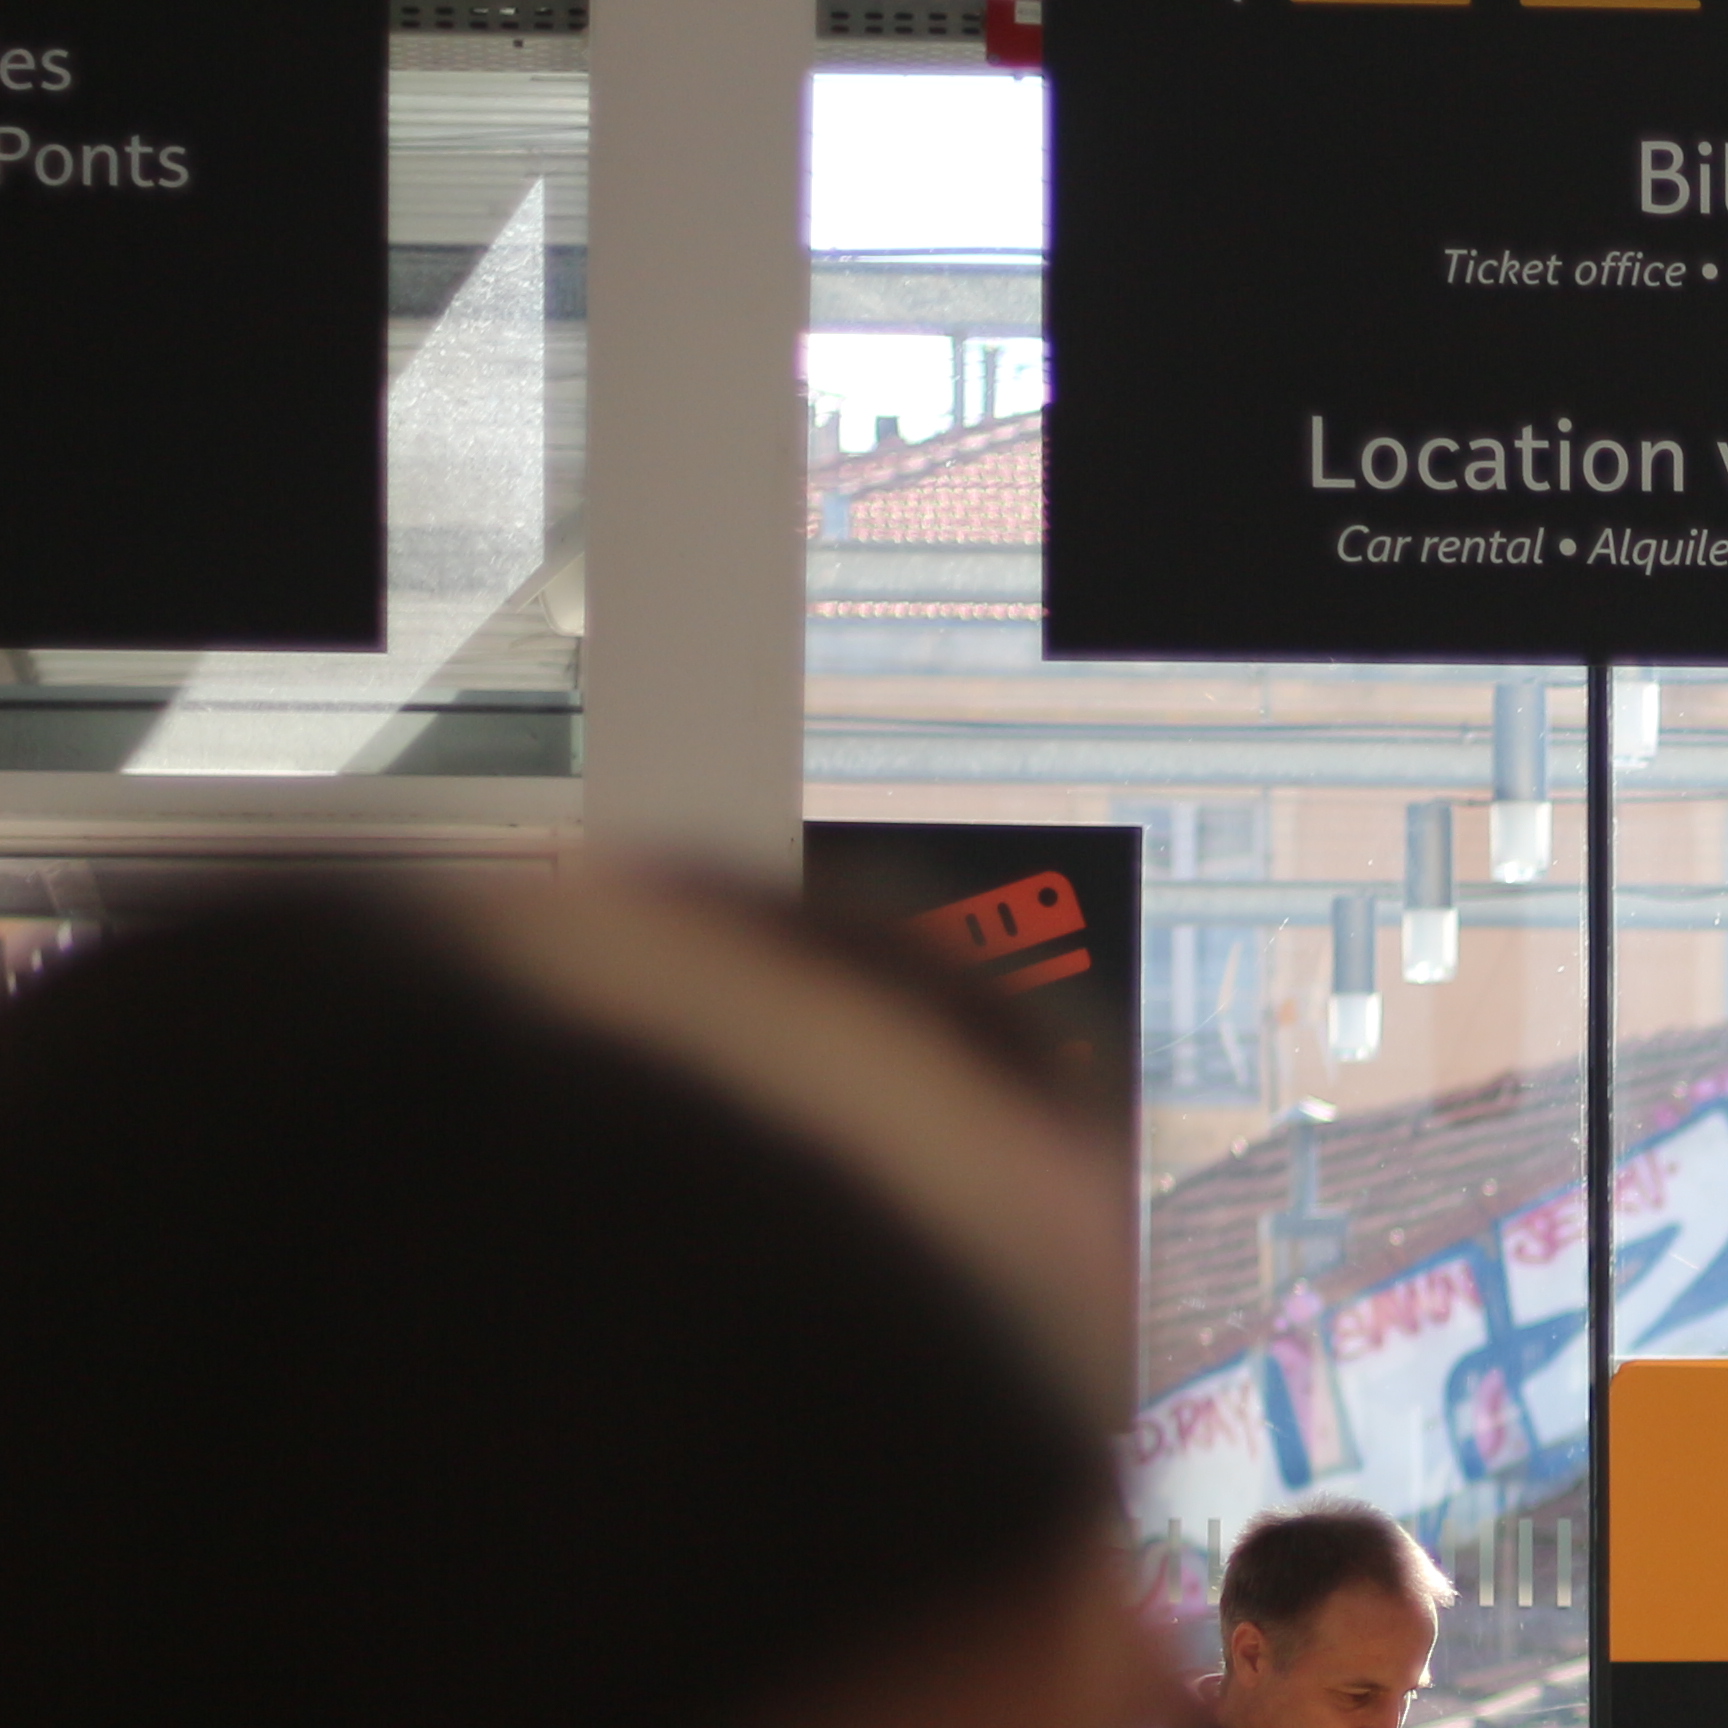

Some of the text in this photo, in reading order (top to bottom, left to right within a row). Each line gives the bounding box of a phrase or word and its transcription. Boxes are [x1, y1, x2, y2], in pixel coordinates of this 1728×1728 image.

[1445, 249, 1563, 287] Ticket
[1575, 251, 1688, 288] office
[1312, 416, 1685, 494] Location
[1338, 525, 1412, 564] Car
[1421, 527, 1545, 566] rental
